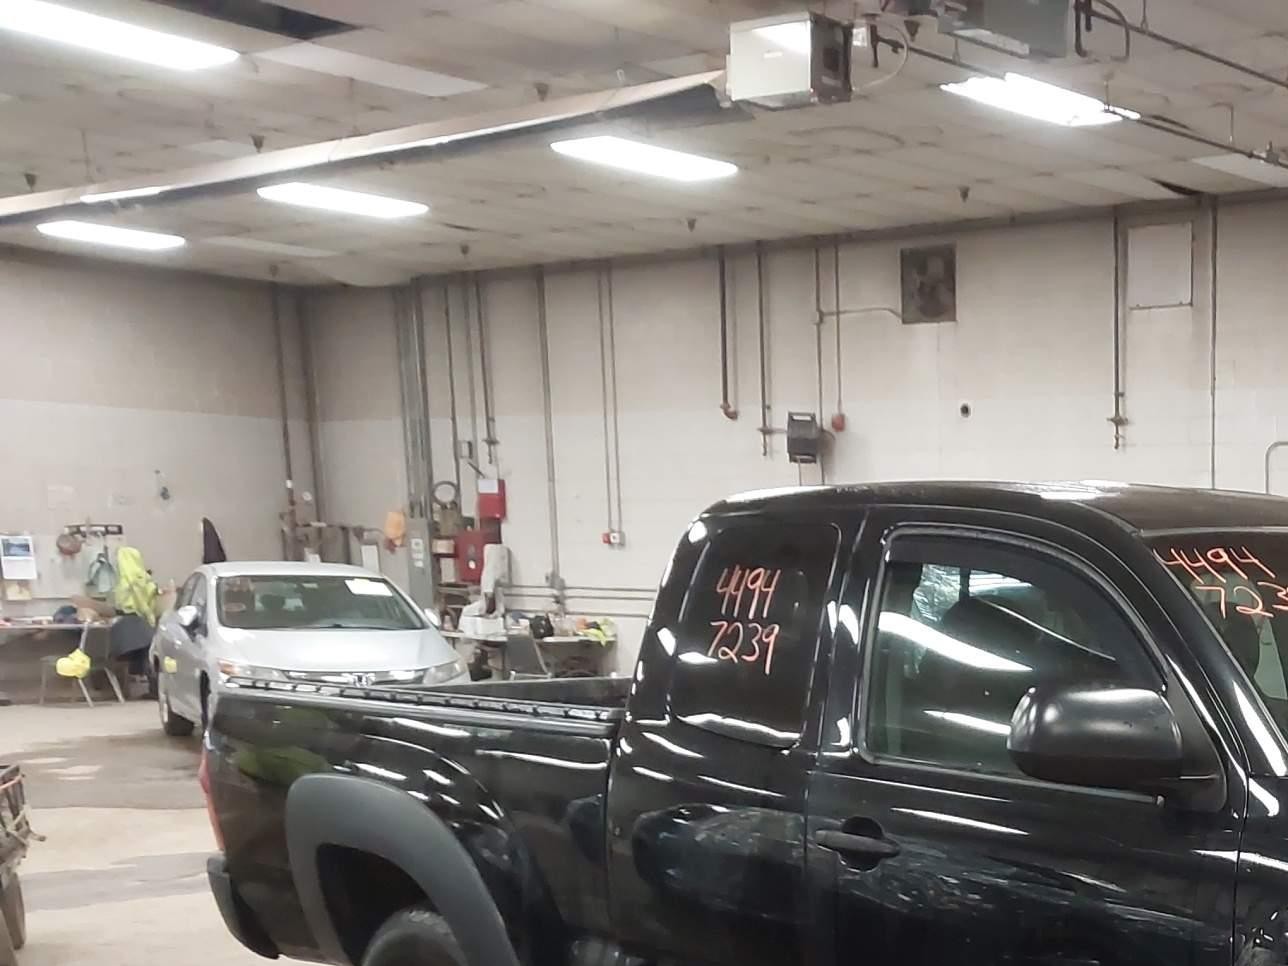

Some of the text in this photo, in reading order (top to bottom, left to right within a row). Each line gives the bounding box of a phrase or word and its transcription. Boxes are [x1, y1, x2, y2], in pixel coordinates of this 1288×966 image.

[716, 565, 781, 619] 4494
[1153, 546, 1276, 584] 4494
[708, 621, 780, 675] 7239
